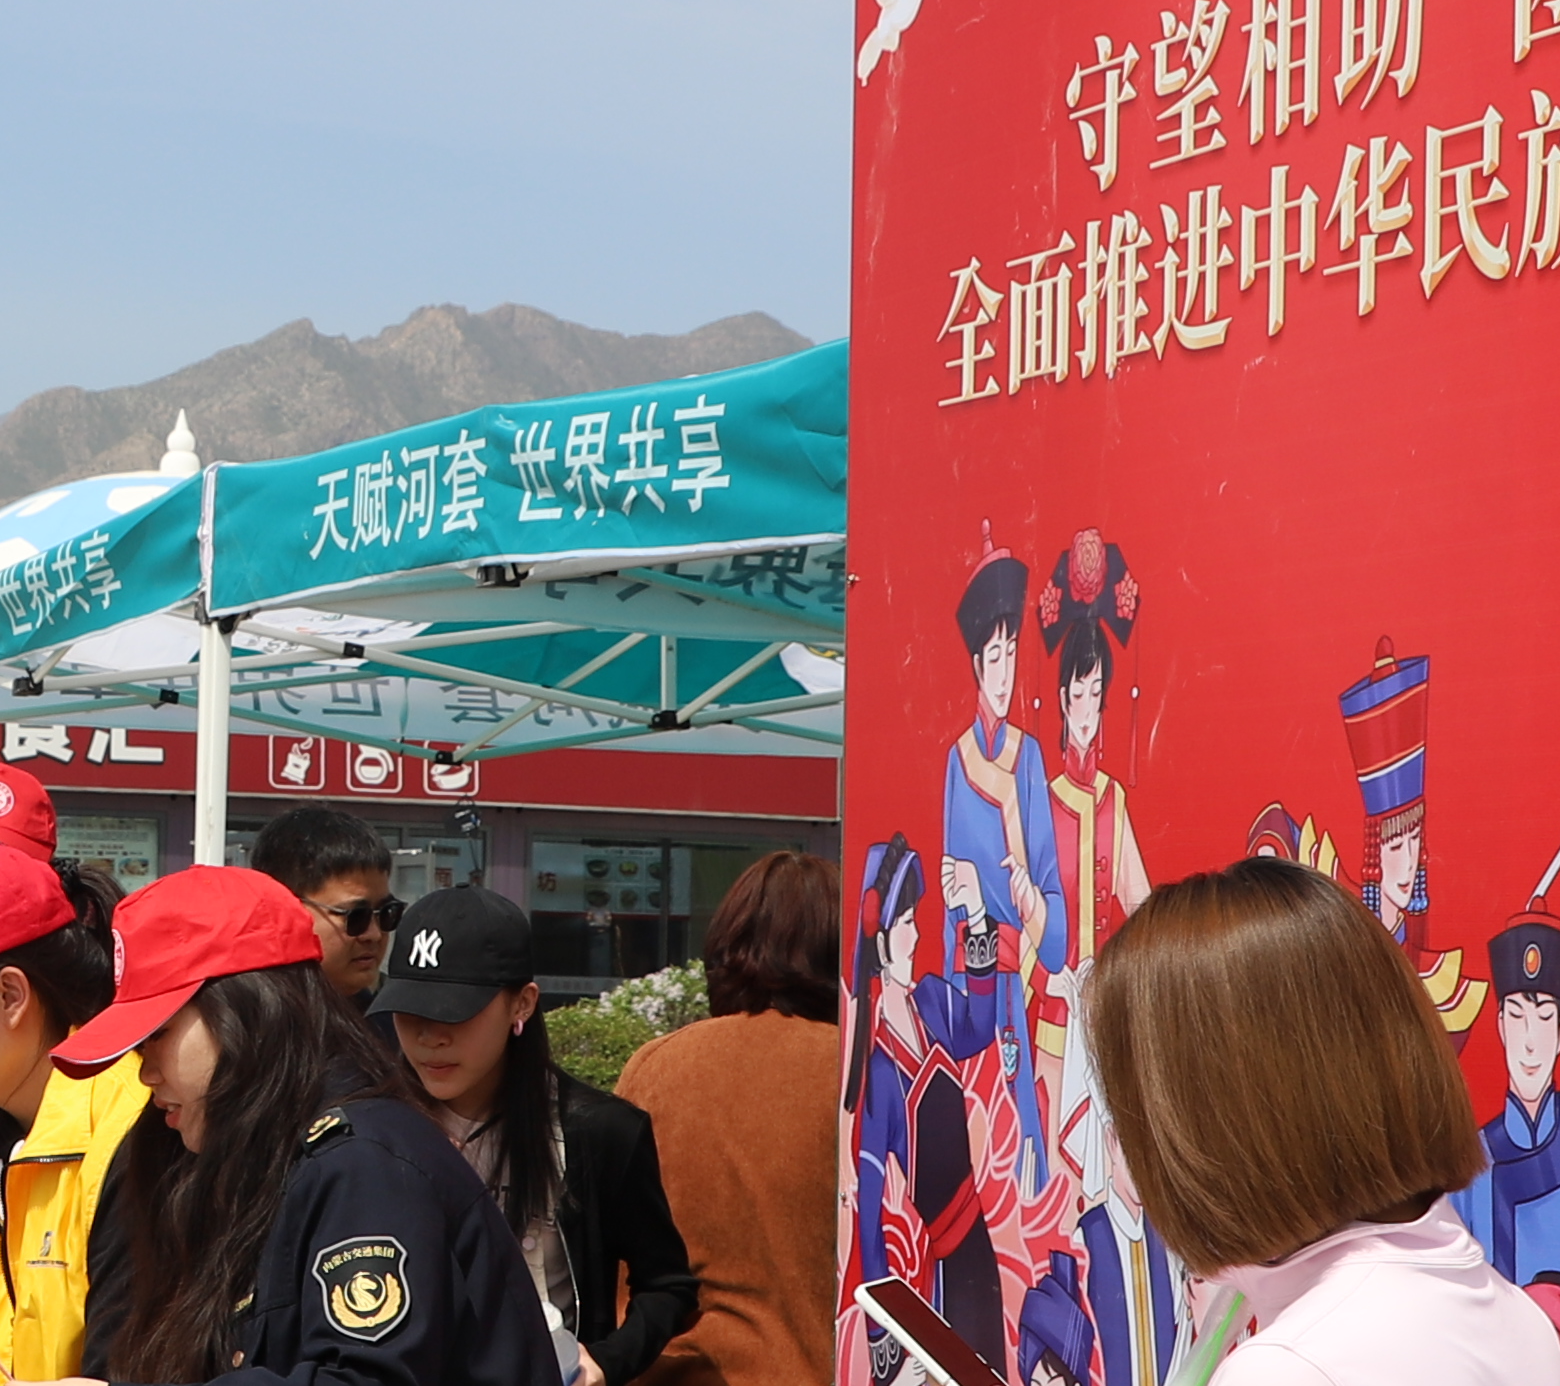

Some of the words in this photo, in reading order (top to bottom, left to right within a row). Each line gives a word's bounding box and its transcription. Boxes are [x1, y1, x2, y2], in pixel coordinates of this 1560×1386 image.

[309, 428, 488, 560] 天赋河套
[510, 393, 731, 522] 世界共享
[408, 928, 443, 969] NY
[322, 1245, 396, 1274] 内蒙古交通集团
